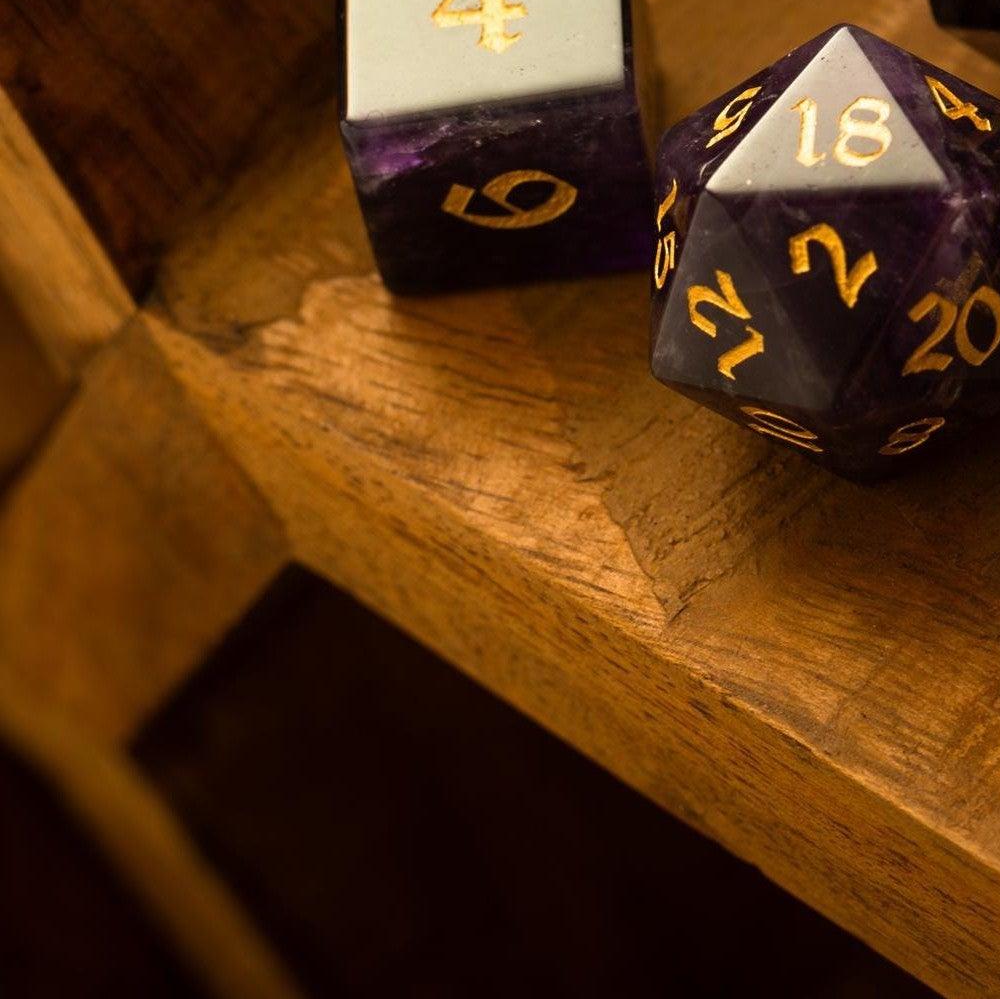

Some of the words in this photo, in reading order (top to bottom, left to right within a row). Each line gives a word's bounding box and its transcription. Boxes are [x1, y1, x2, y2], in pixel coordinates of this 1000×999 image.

[791, 96, 893, 167] 18
[927, 76, 993, 131] 4
[789, 222, 879, 309] 2
[687, 269, 764, 380] 12
